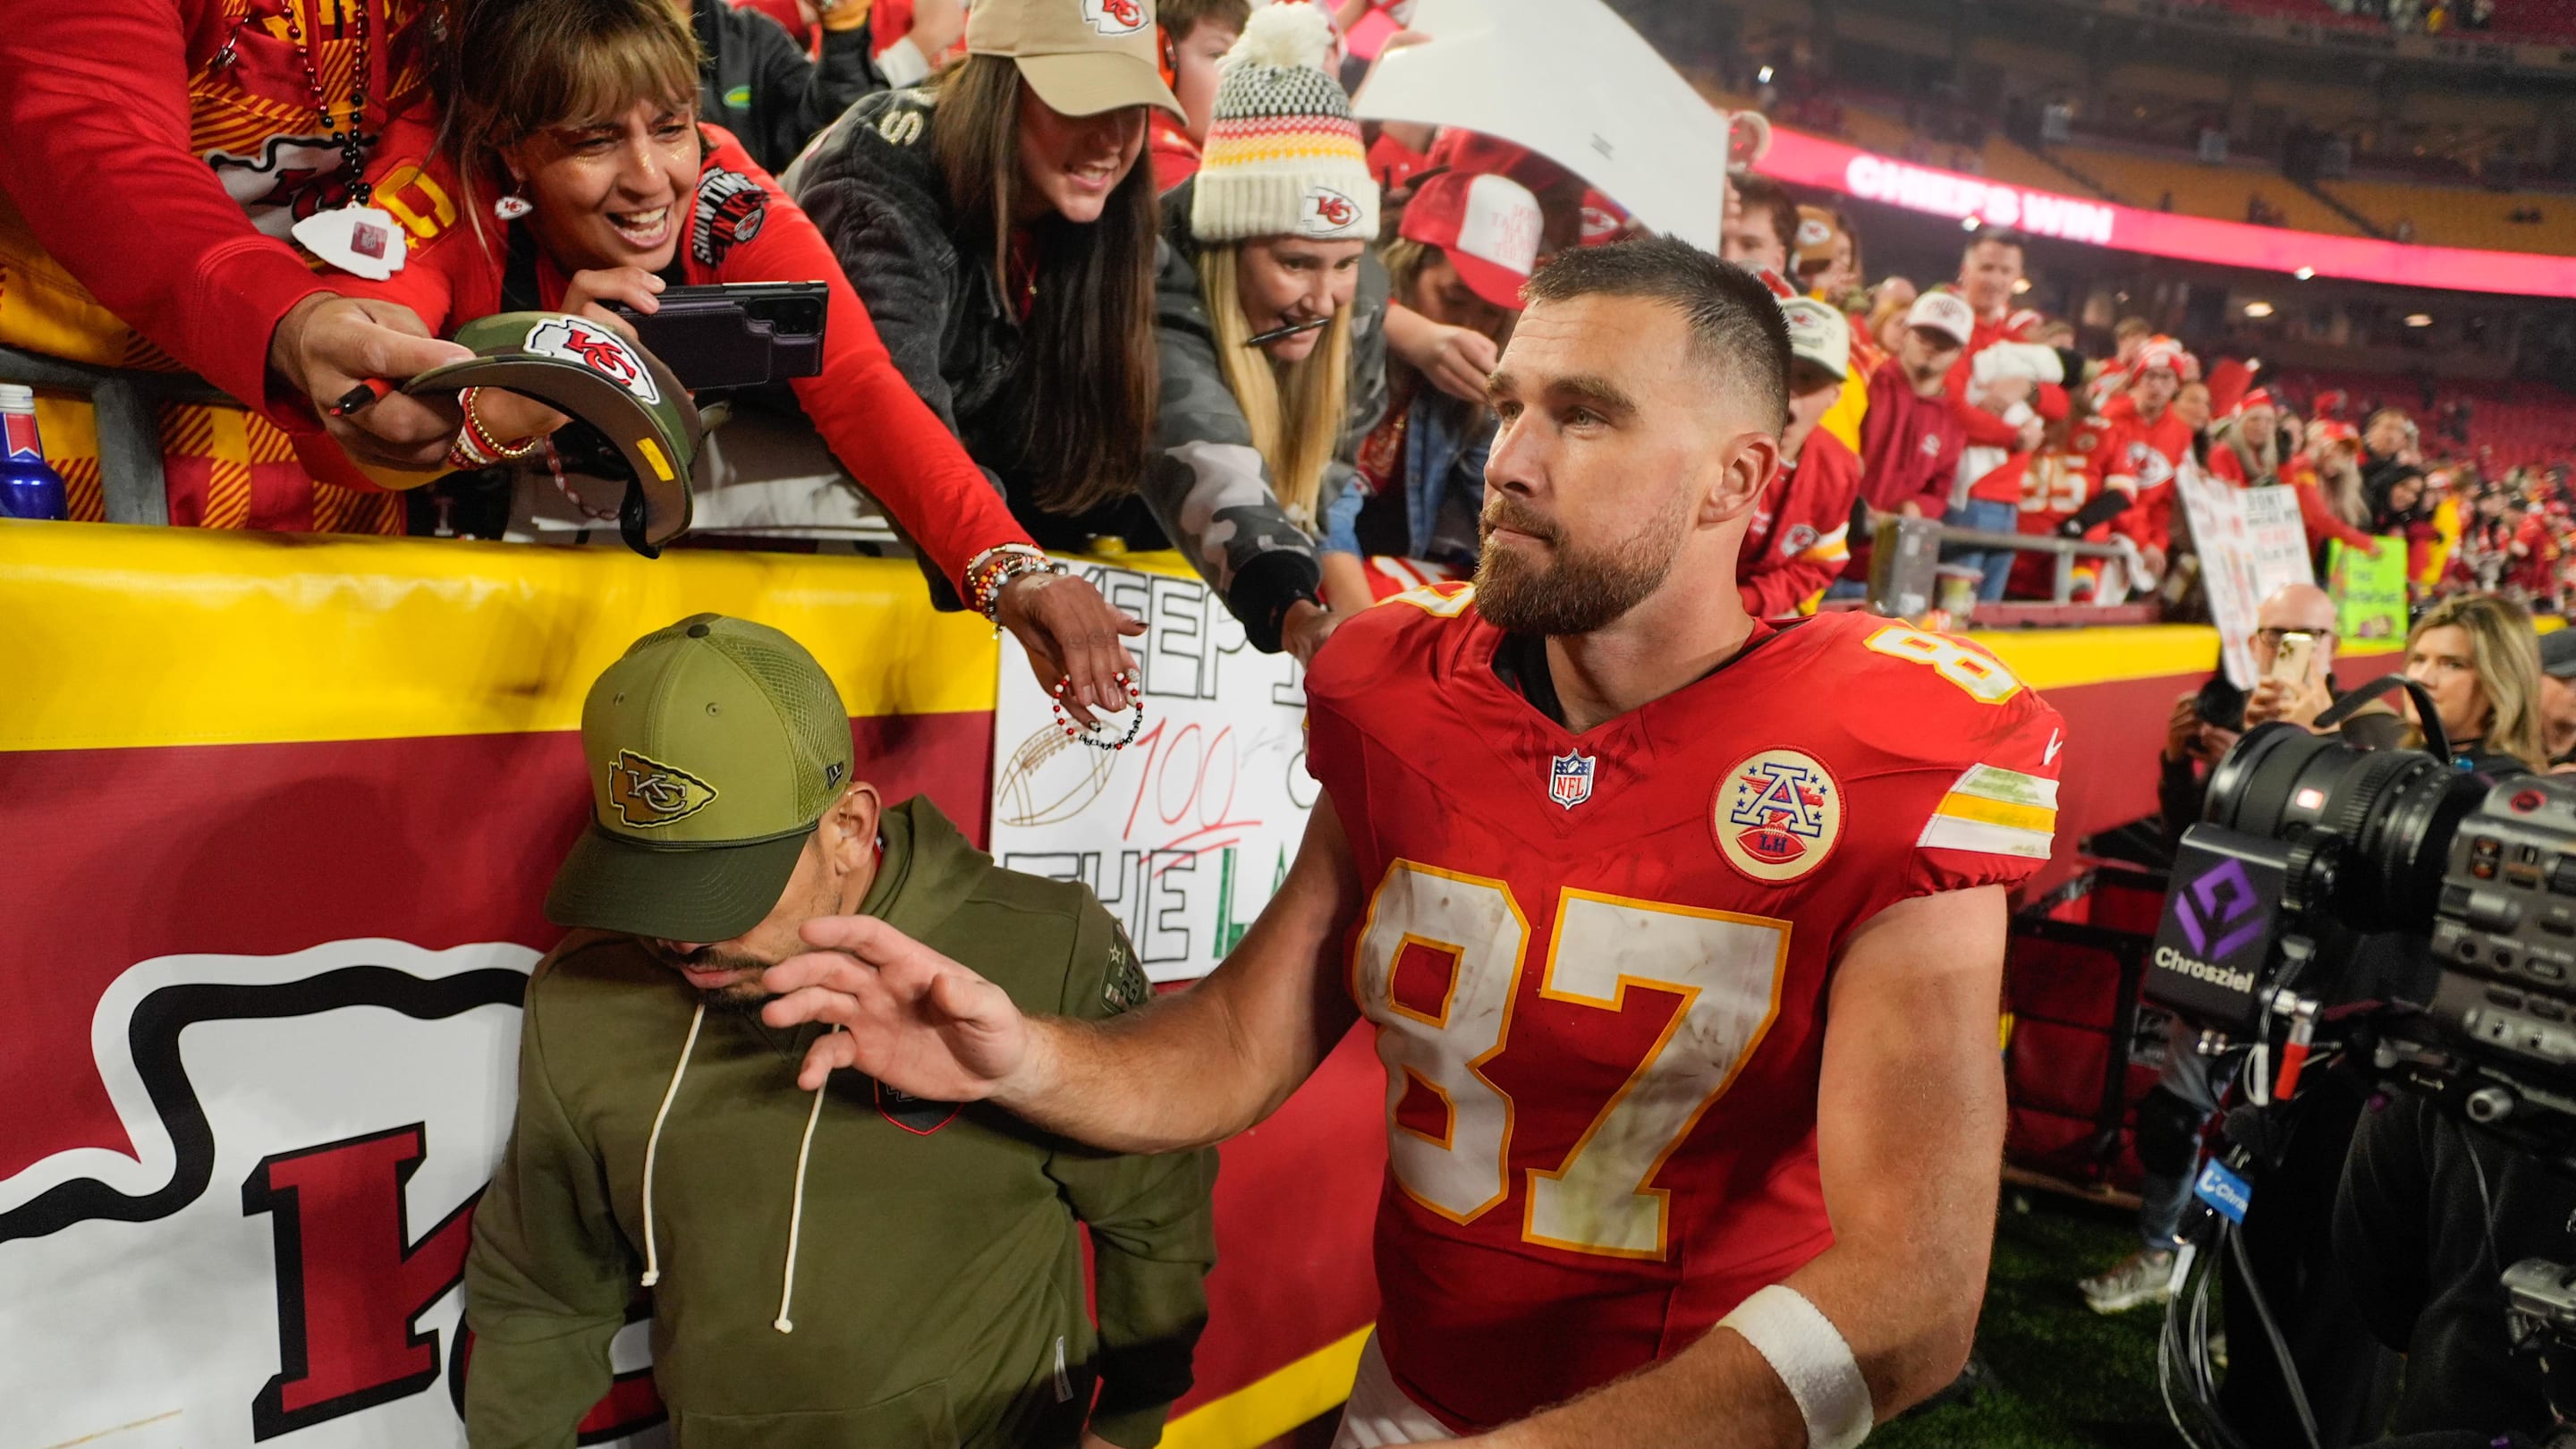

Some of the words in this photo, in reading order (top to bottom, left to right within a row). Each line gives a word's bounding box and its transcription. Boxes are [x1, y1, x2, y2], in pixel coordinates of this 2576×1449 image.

[692, 172, 763, 265] SHOWTIME
[1317, 196, 1352, 225] KC
[1846, 156, 2020, 227] CHIEFS
[2022, 191, 2114, 244] WIN
[563, 328, 637, 386] KC
[1863, 625, 2024, 705] 8
[627, 770, 687, 812] KC
[1123, 717, 1236, 841] 100
[1555, 775, 1585, 798] NFL
[1731, 762, 1822, 837] A
[1758, 834, 1787, 853] LH
[2155, 946, 2254, 995] Chrosziel
[1352, 857, 1793, 1262] 87
